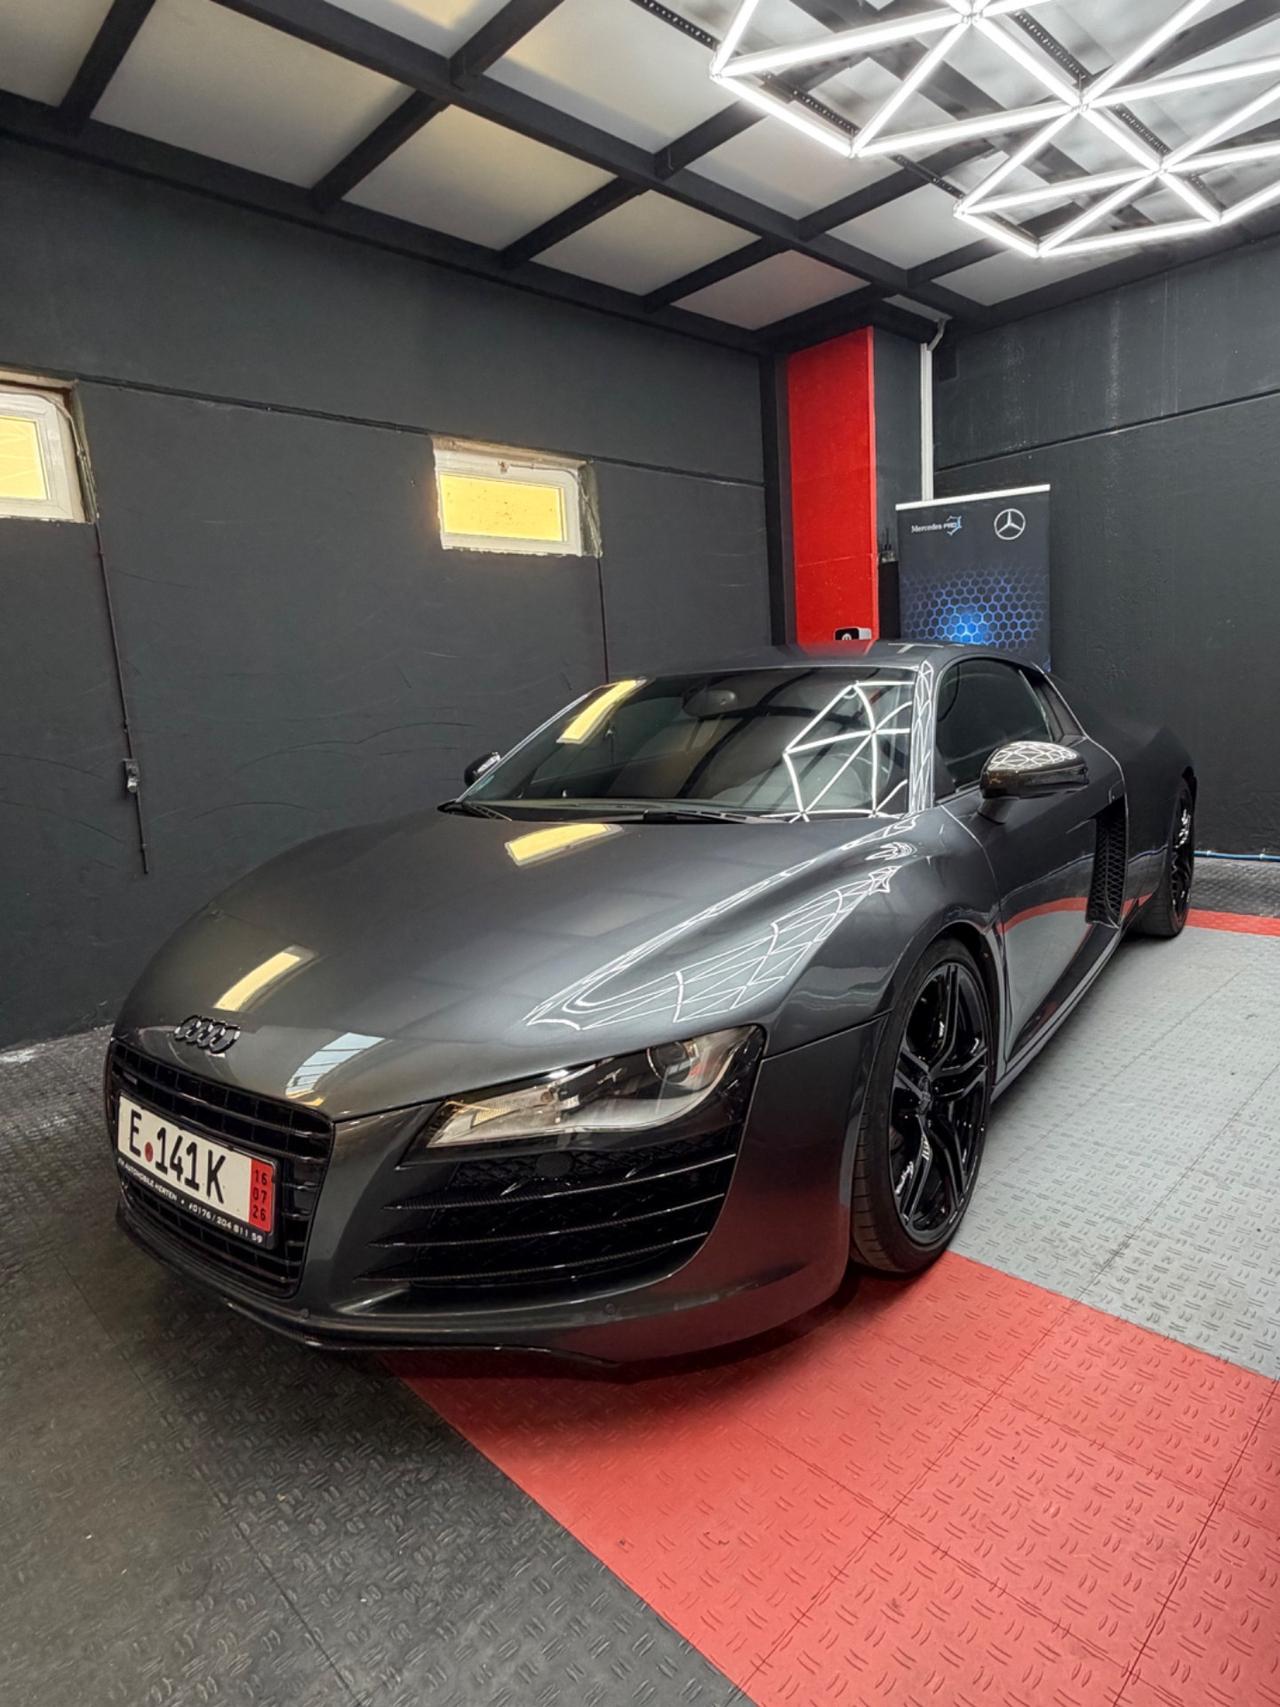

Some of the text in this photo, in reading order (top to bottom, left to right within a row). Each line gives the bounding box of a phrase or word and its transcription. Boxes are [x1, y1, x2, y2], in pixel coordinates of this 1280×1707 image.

[911, 522, 942, 533] Mercedes
[129, 1108, 226, 1204] E 141K
[255, 1169, 268, 1186] 16
[252, 1187, 268, 1204] 07
[252, 1204, 267, 1222] 26
